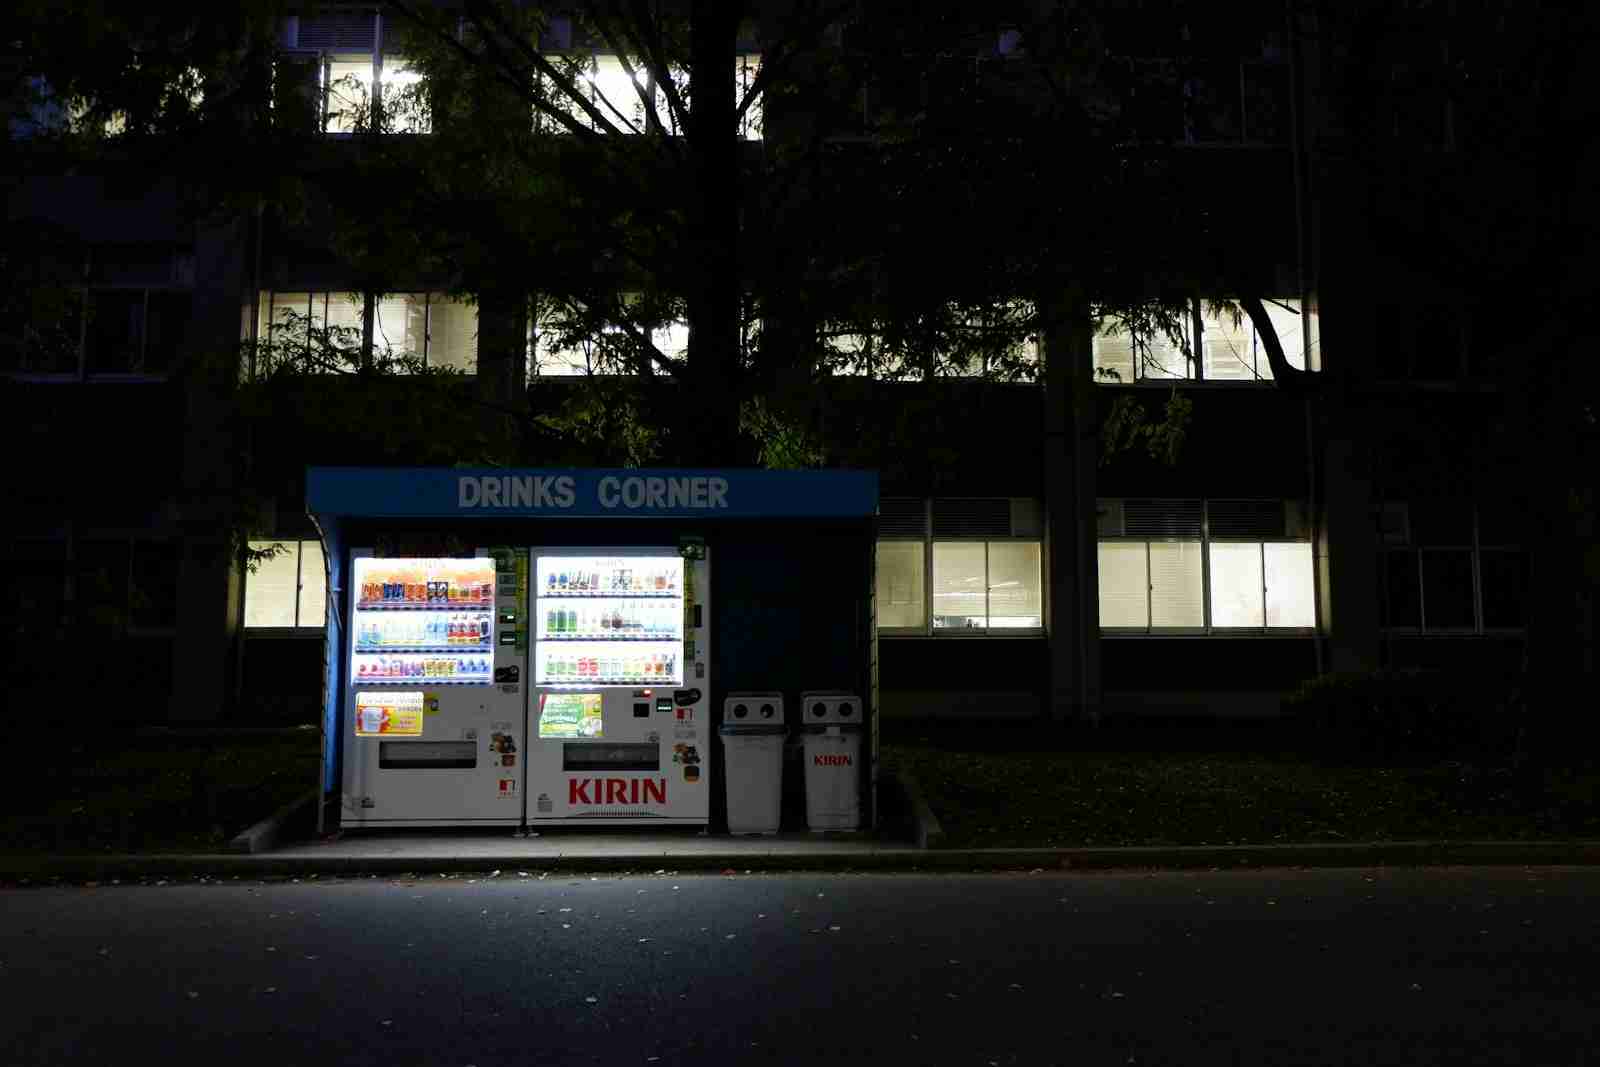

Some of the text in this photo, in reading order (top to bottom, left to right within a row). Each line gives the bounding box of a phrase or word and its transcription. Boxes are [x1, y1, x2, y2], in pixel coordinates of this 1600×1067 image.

[457, 475, 729, 509] DRINKS CORNER
[814, 754, 852, 767] KIRIN
[568, 778, 667, 805] KIRIN
